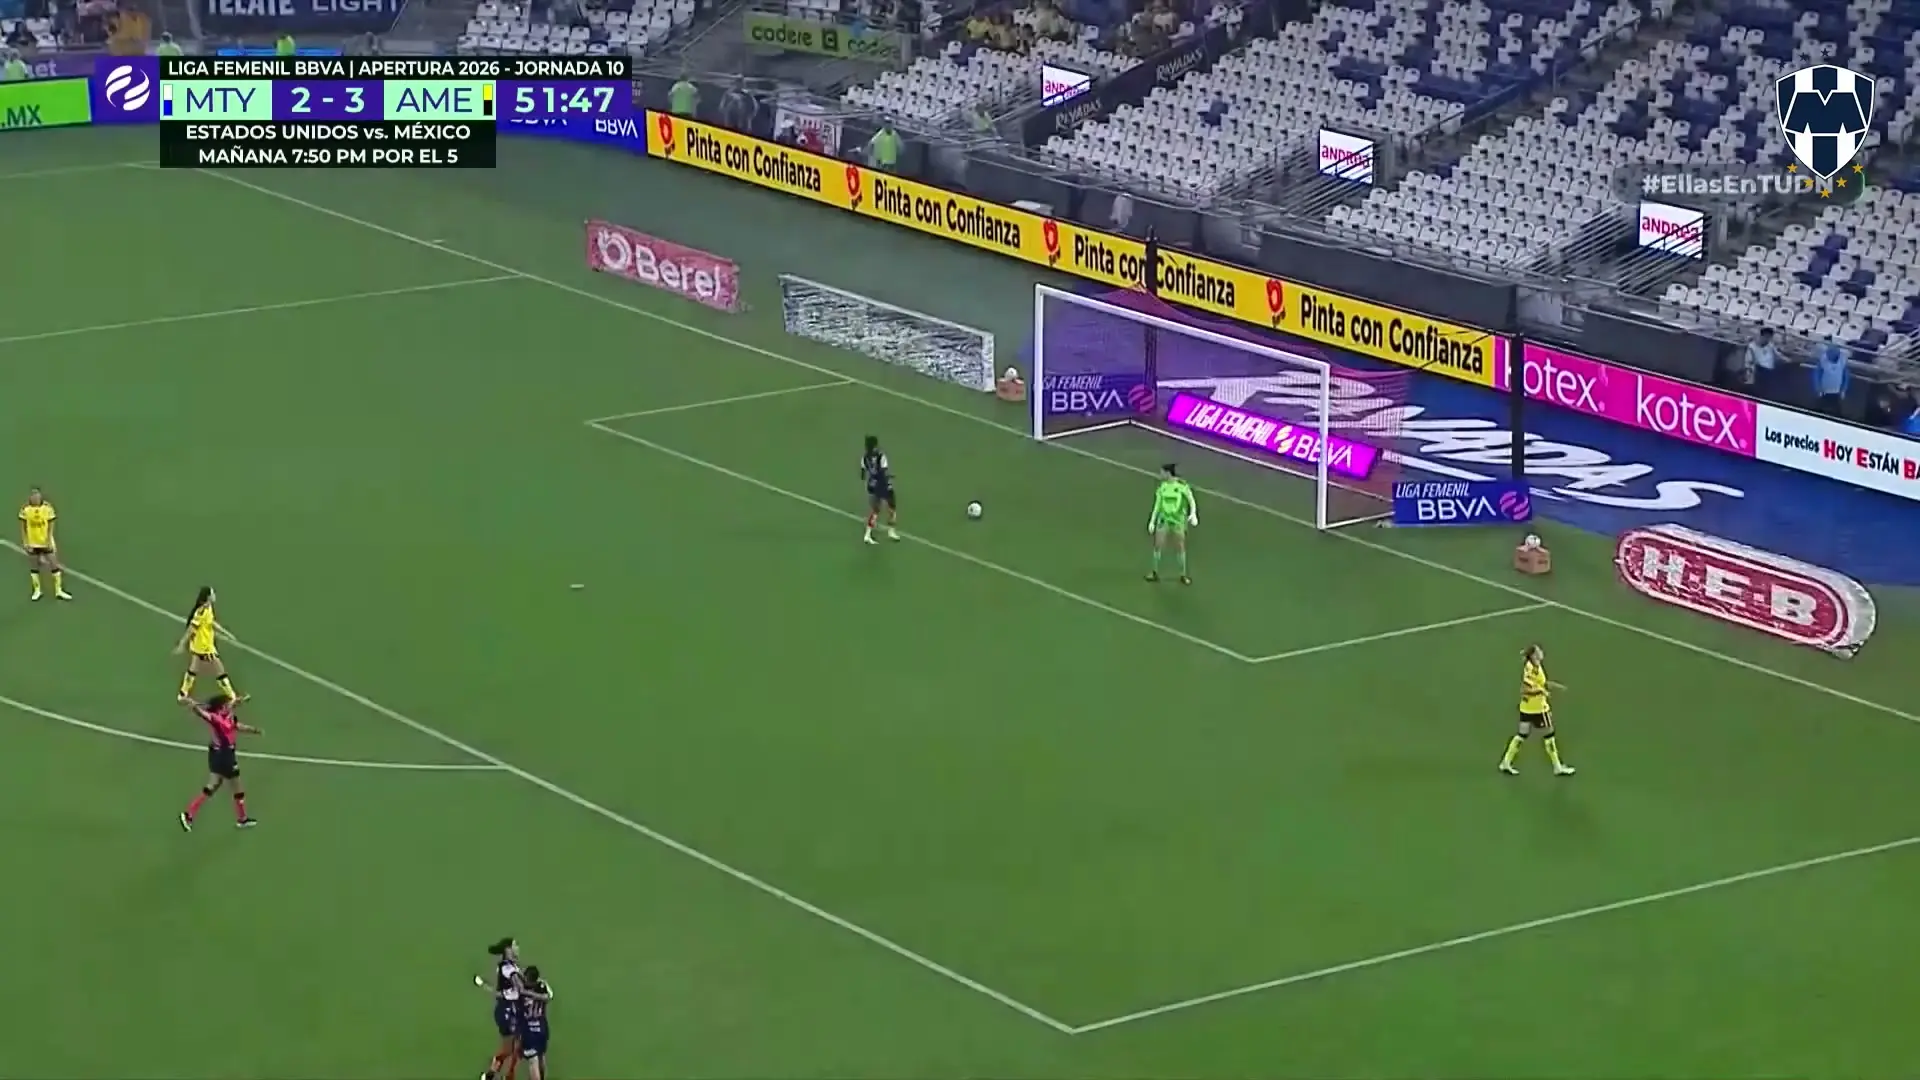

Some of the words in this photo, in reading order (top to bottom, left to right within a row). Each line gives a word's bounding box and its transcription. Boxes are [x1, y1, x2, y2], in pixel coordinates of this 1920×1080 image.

[686, 127, 721, 164] Pinta
[725, 144, 749, 172] con
[753, 146, 821, 192] Confianza
[874, 179, 911, 218] Pinta
[915, 197, 942, 227] con
[946, 199, 1020, 249] Confianza
[635, 244, 721, 301] Berel
[1074, 233, 1114, 274] Pinta
[1155, 256, 1235, 308] Confianza
[1300, 294, 1345, 338] Pinta
[1350, 314, 1383, 348] con
[1389, 319, 1483, 375] Confianza
[1052, 389, 1124, 412] BBVA
[1057, 375, 1102, 390] FEMENIL
[1185, 402, 1219, 433] LIGA
[1218, 408, 1278, 447] FEMENIL
[1765, 426, 1782, 444] Los
[1784, 435, 1820, 454] precios
[1823, 439, 1854, 464] HOY
[1856, 447, 1900, 476] ESTÁN
[1395, 484, 1420, 499] LIGA
[1422, 482, 1470, 498] FEMENIL
[1416, 495, 1497, 520] BBVA
